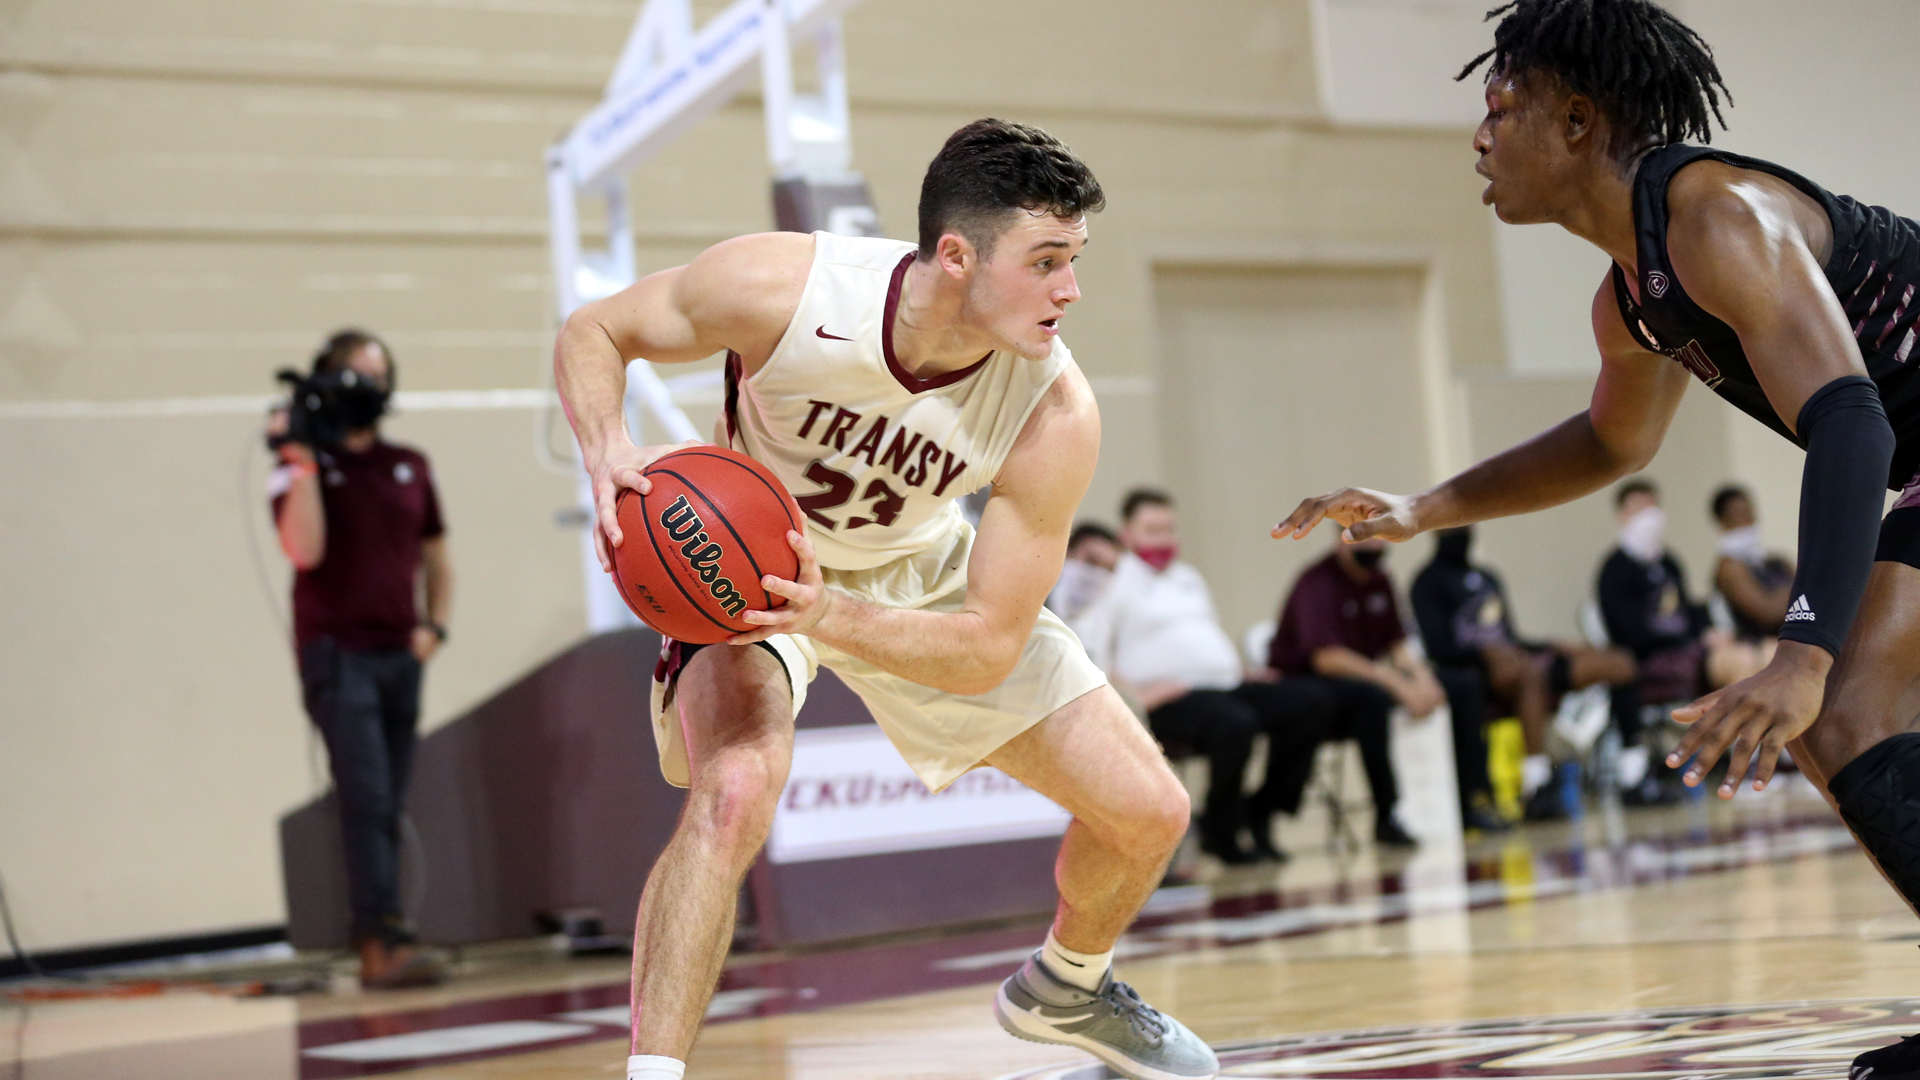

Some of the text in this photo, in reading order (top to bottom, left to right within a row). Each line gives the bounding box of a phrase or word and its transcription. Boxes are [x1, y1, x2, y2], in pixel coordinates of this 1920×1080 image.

[796, 398, 968, 497] TRANSY
[791, 458, 909, 532] 23
[636, 584, 666, 613] EKU
[659, 494, 748, 618] Wilson
